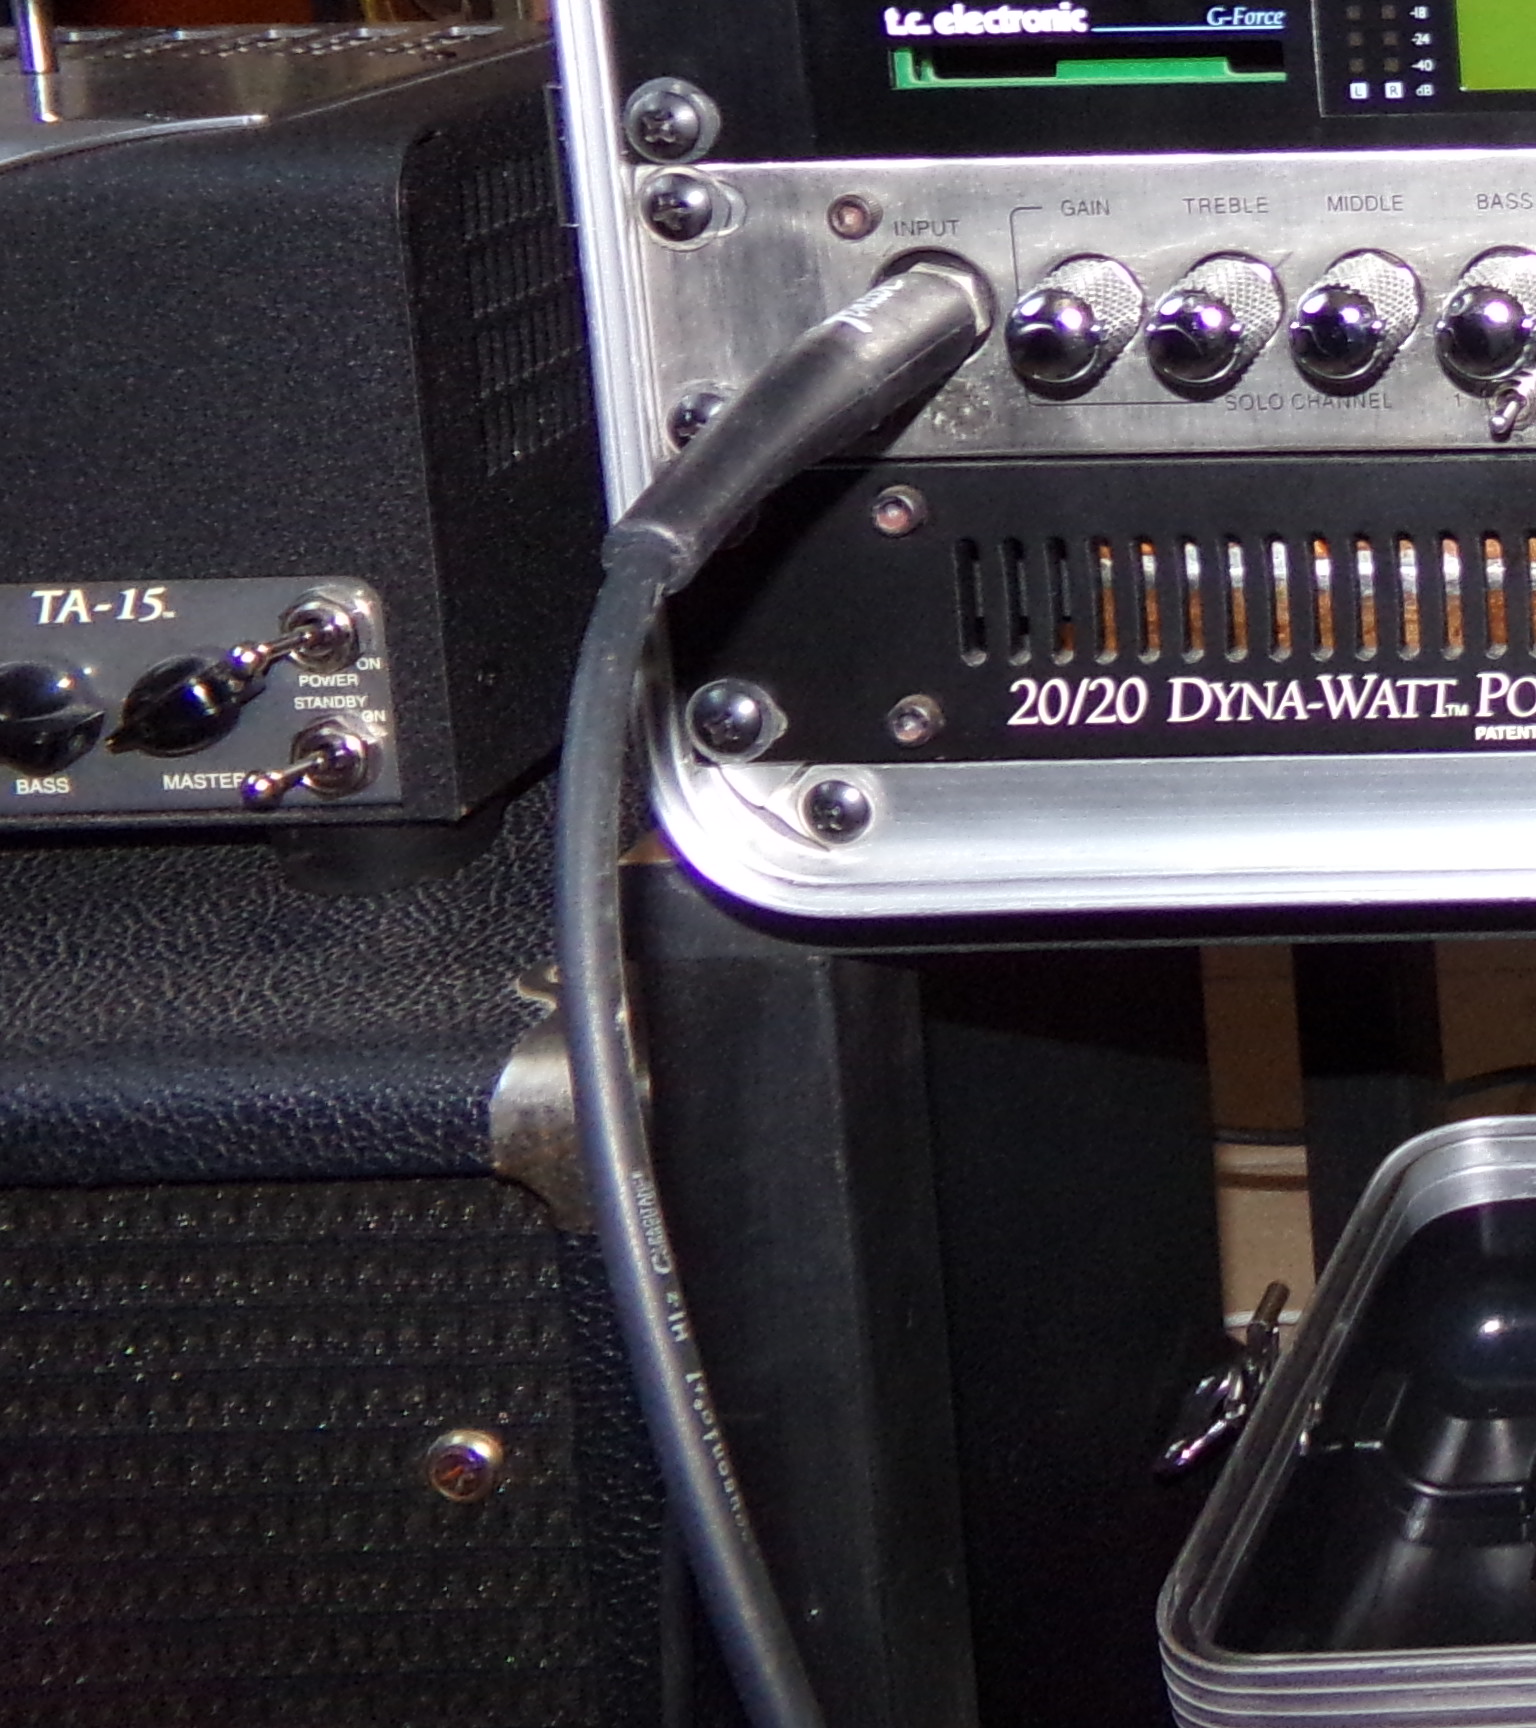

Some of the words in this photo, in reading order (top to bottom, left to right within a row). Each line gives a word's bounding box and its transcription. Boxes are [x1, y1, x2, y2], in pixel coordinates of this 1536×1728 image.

[933, 2, 1090, 34] electronic
[1206, 6, 1286, 27] G-Force
[1409, 7, 1429, 20] -18
[1411, 33, 1432, 46] -24
[1411, 60, 1434, 72] -40
[1415, 85, 1434, 96] dB
[1060, 198, 1111, 218] GAIN
[1183, 196, 1269, 215] TREBLE
[1327, 194, 1403, 213] MIDDLE
[1476, 193, 1534, 211] BASS
[893, 219, 959, 237] INPUT
[1224, 393, 1284, 412] SOLO
[1291, 392, 1393, 411] CHANNEL
[31, 586, 167, 624] TA-15
[355, 657, 381, 671] ON
[298, 673, 359, 688] POWER
[293, 694, 369, 710] STANDBY
[1008, 676, 1148, 727] 20/20
[361, 709, 386, 723] ON
[16, 777, 71, 795] BASS
